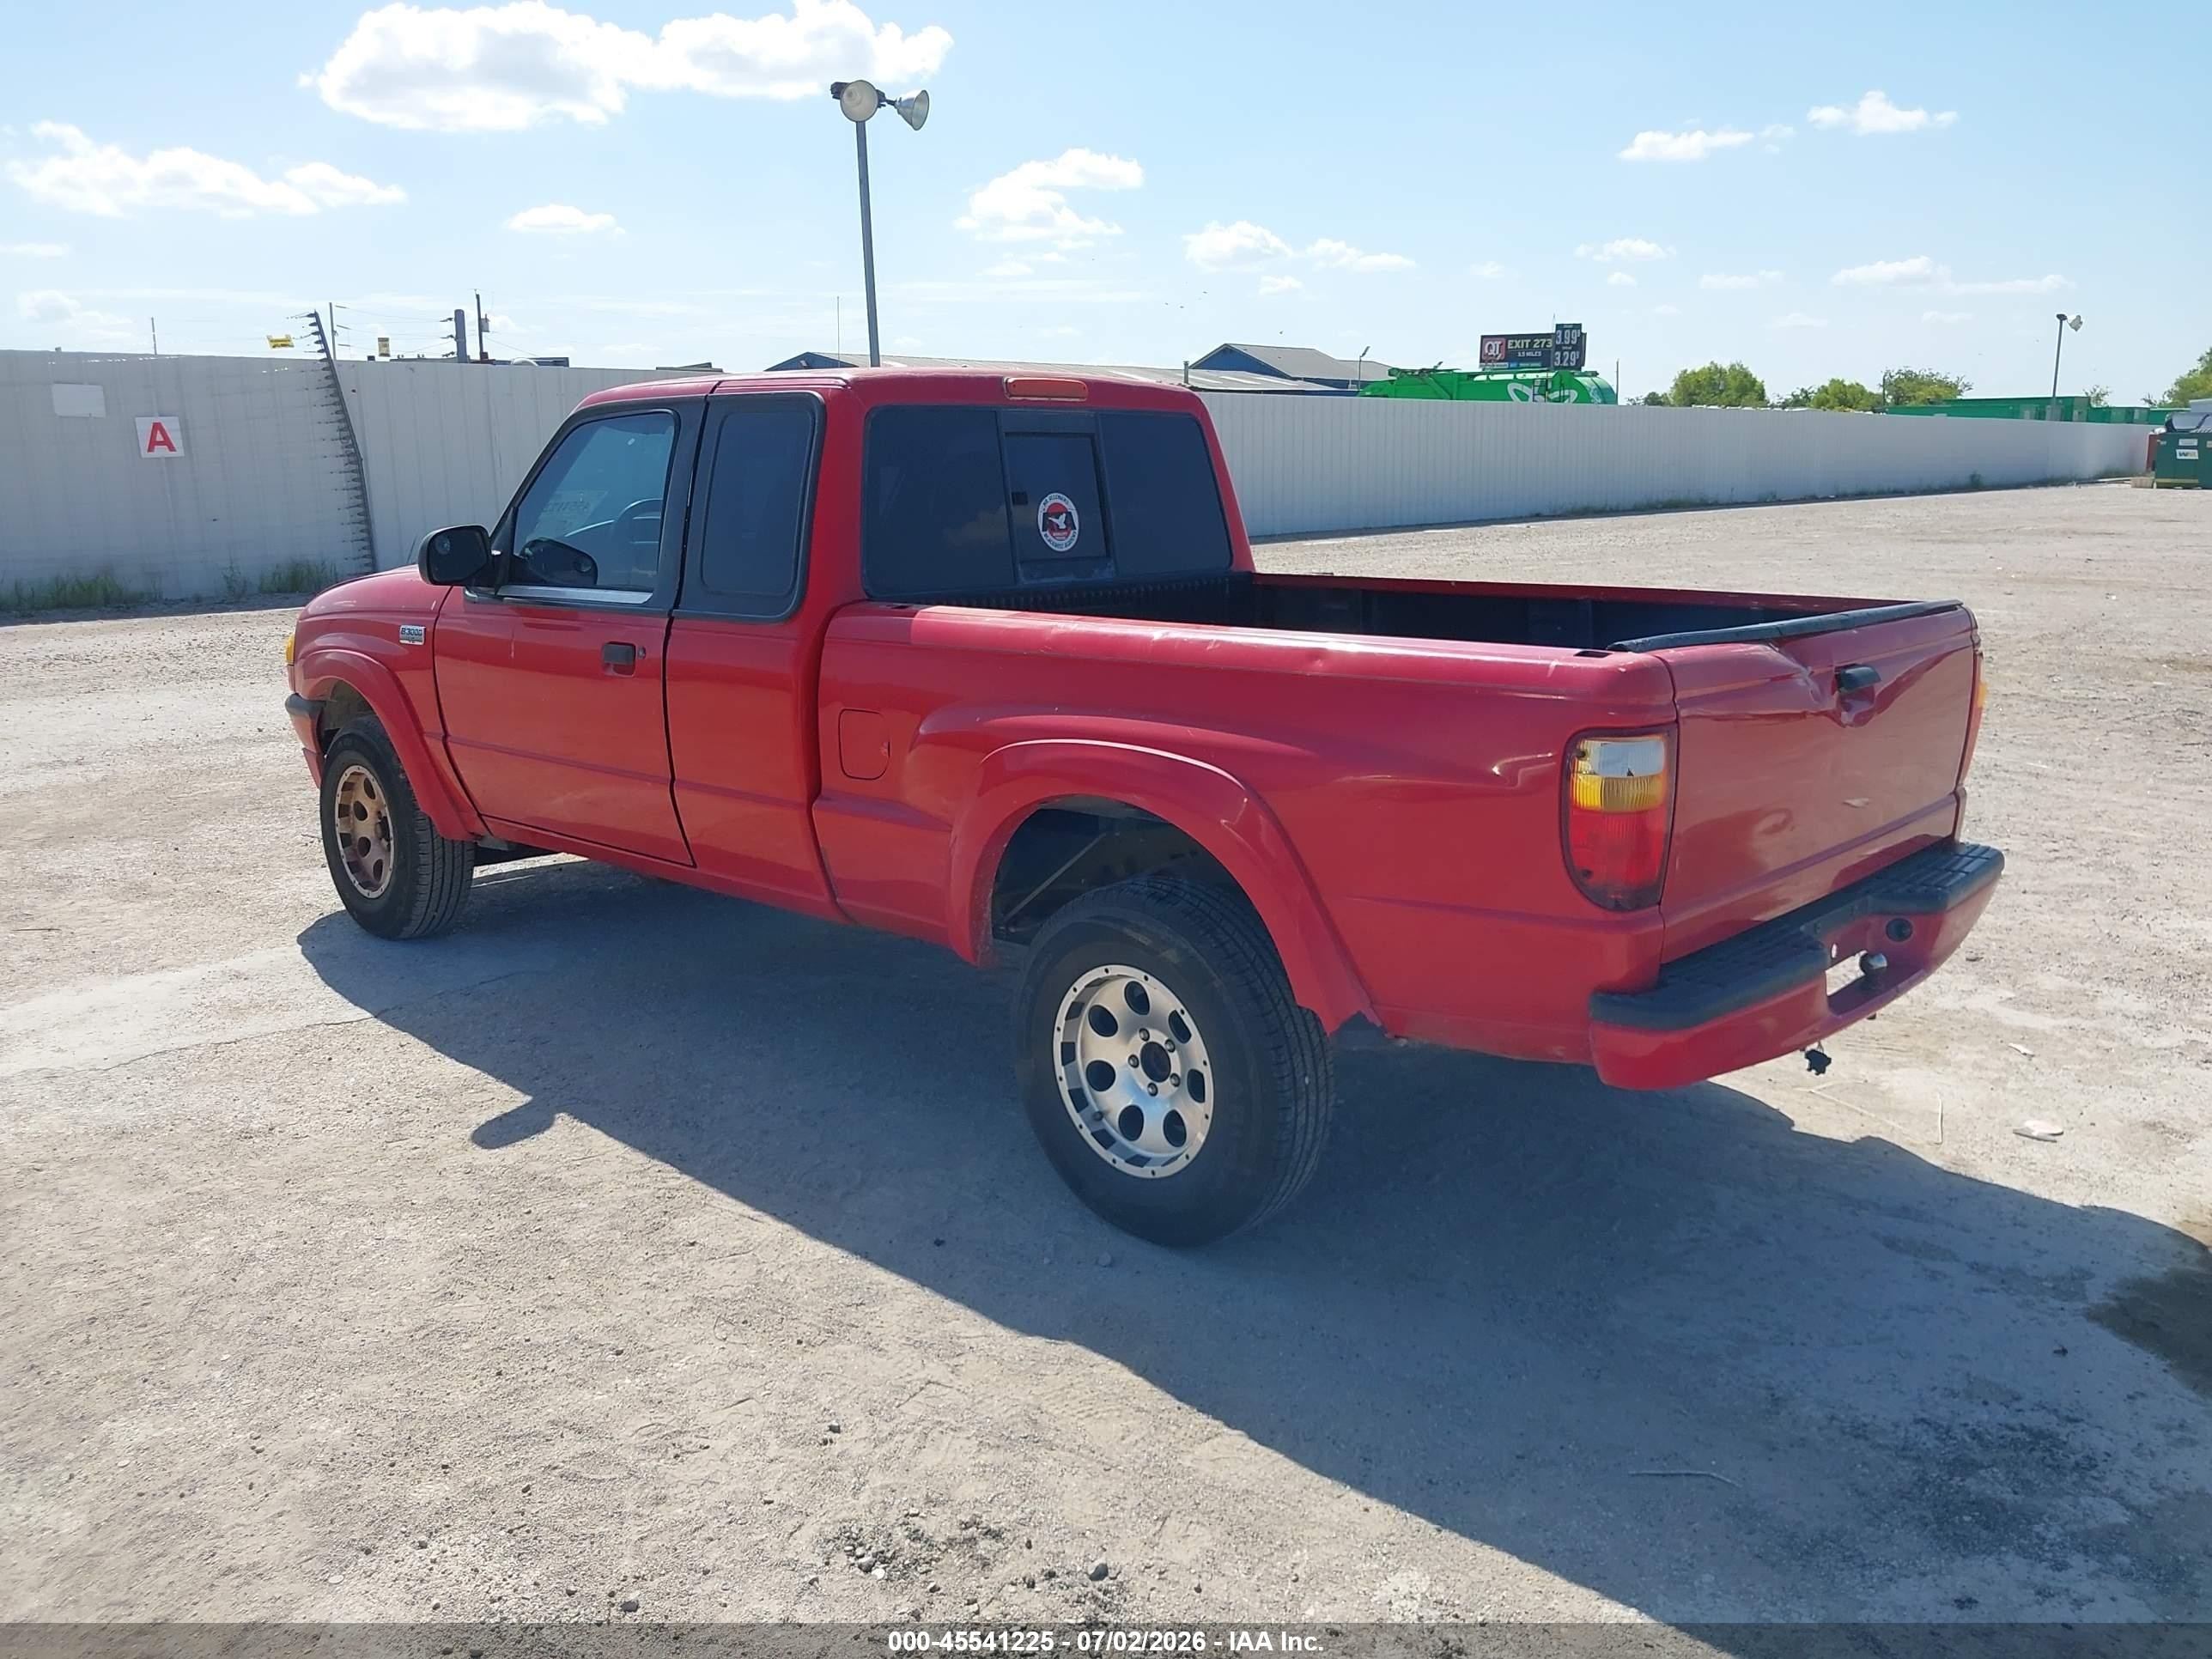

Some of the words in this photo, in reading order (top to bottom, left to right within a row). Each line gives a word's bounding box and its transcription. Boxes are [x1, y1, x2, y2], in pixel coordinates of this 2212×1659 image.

[1508, 340, 1530, 349] EXIT
[1533, 338, 1553, 348] 273
[147, 422, 177, 453] A
